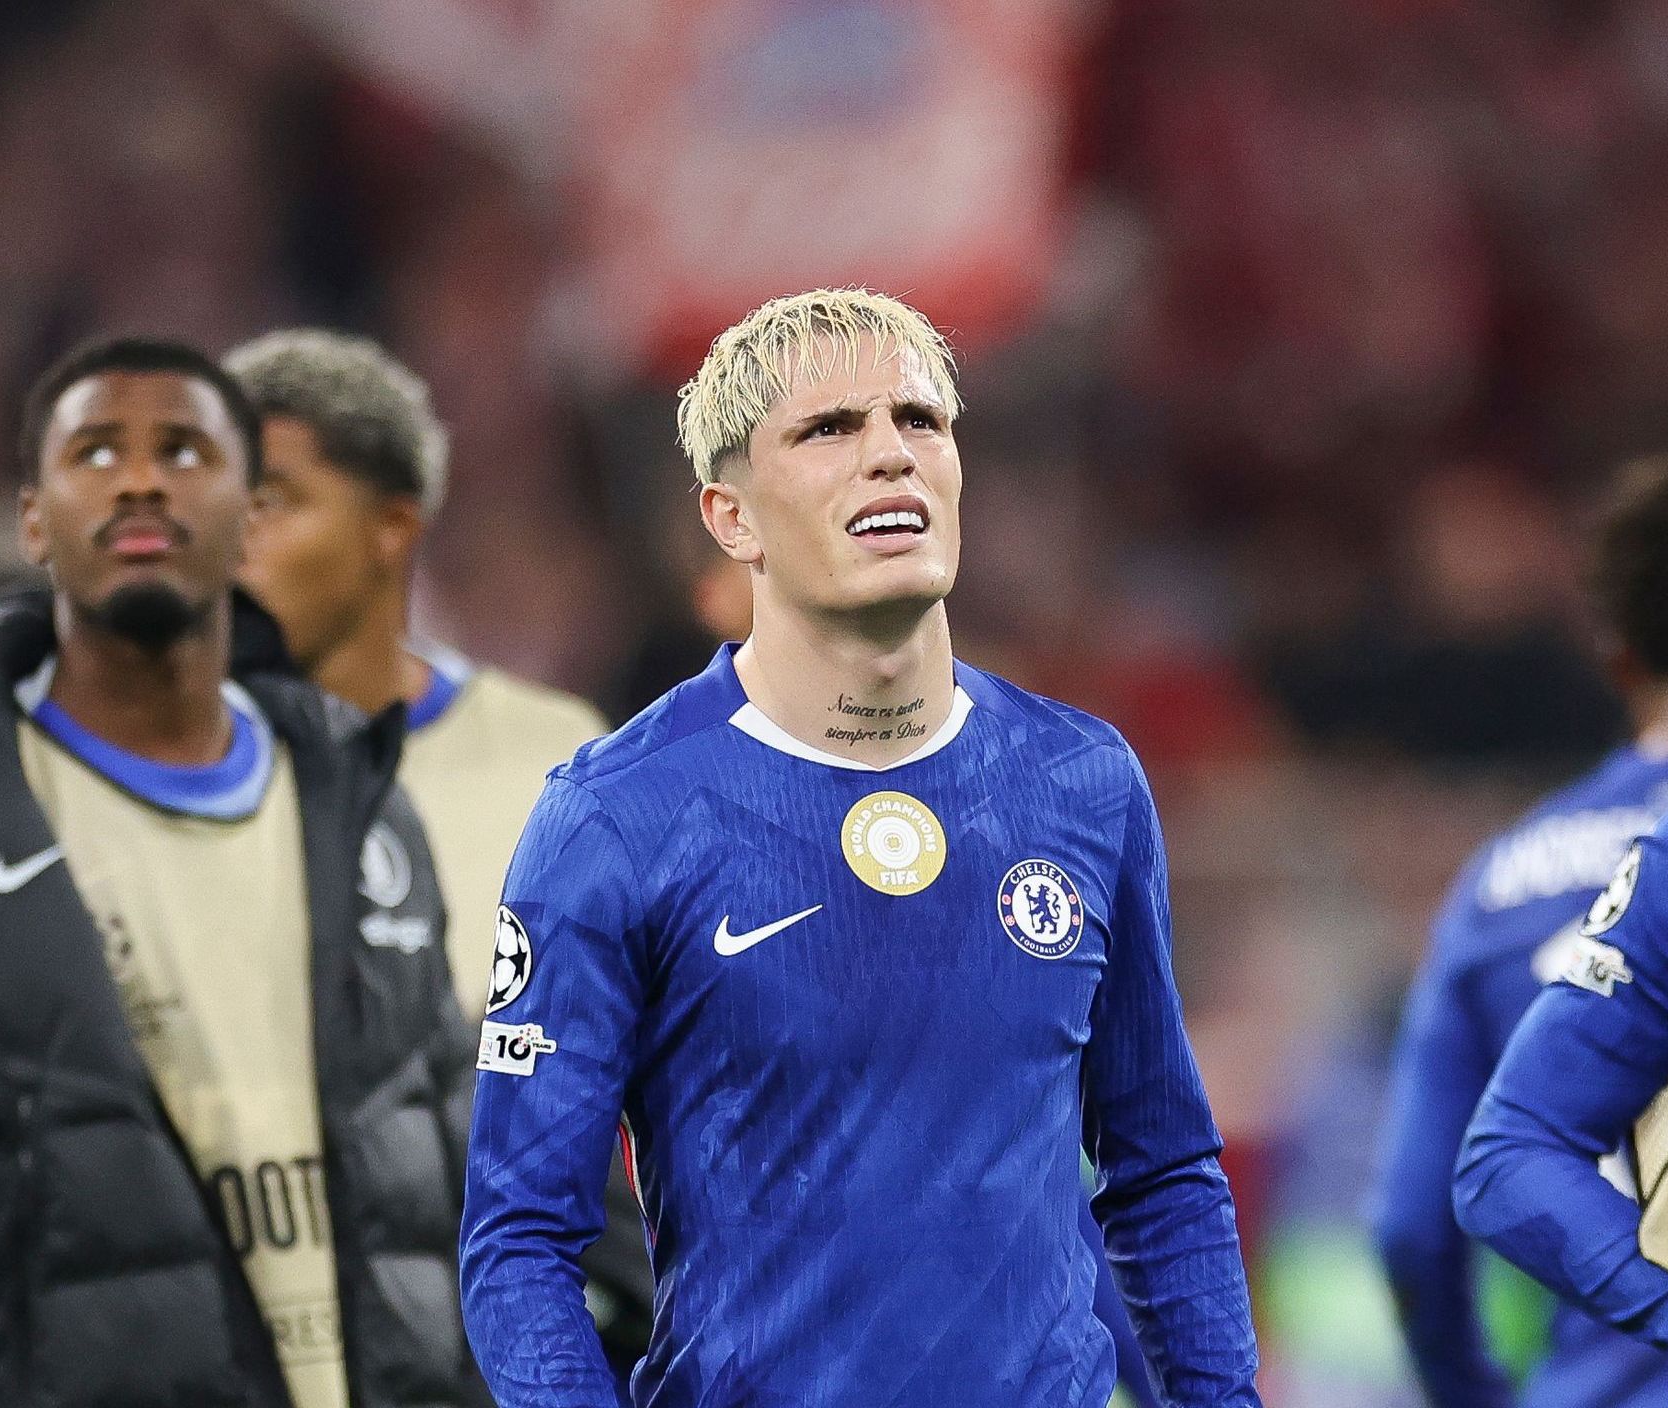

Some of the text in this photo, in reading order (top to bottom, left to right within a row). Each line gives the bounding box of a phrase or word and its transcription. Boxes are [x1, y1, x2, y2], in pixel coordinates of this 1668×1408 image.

[878, 707, 893, 718] es
[825, 720, 926, 746] siempre es Dios
[851, 800, 938, 857] WORLD CHAMPIONS
[880, 870, 919, 885] FIFA
[1009, 863, 1062, 885] CHELSEA
[1020, 936, 1057, 954] FOOTBALL
[496, 1035, 531, 1061] 10
